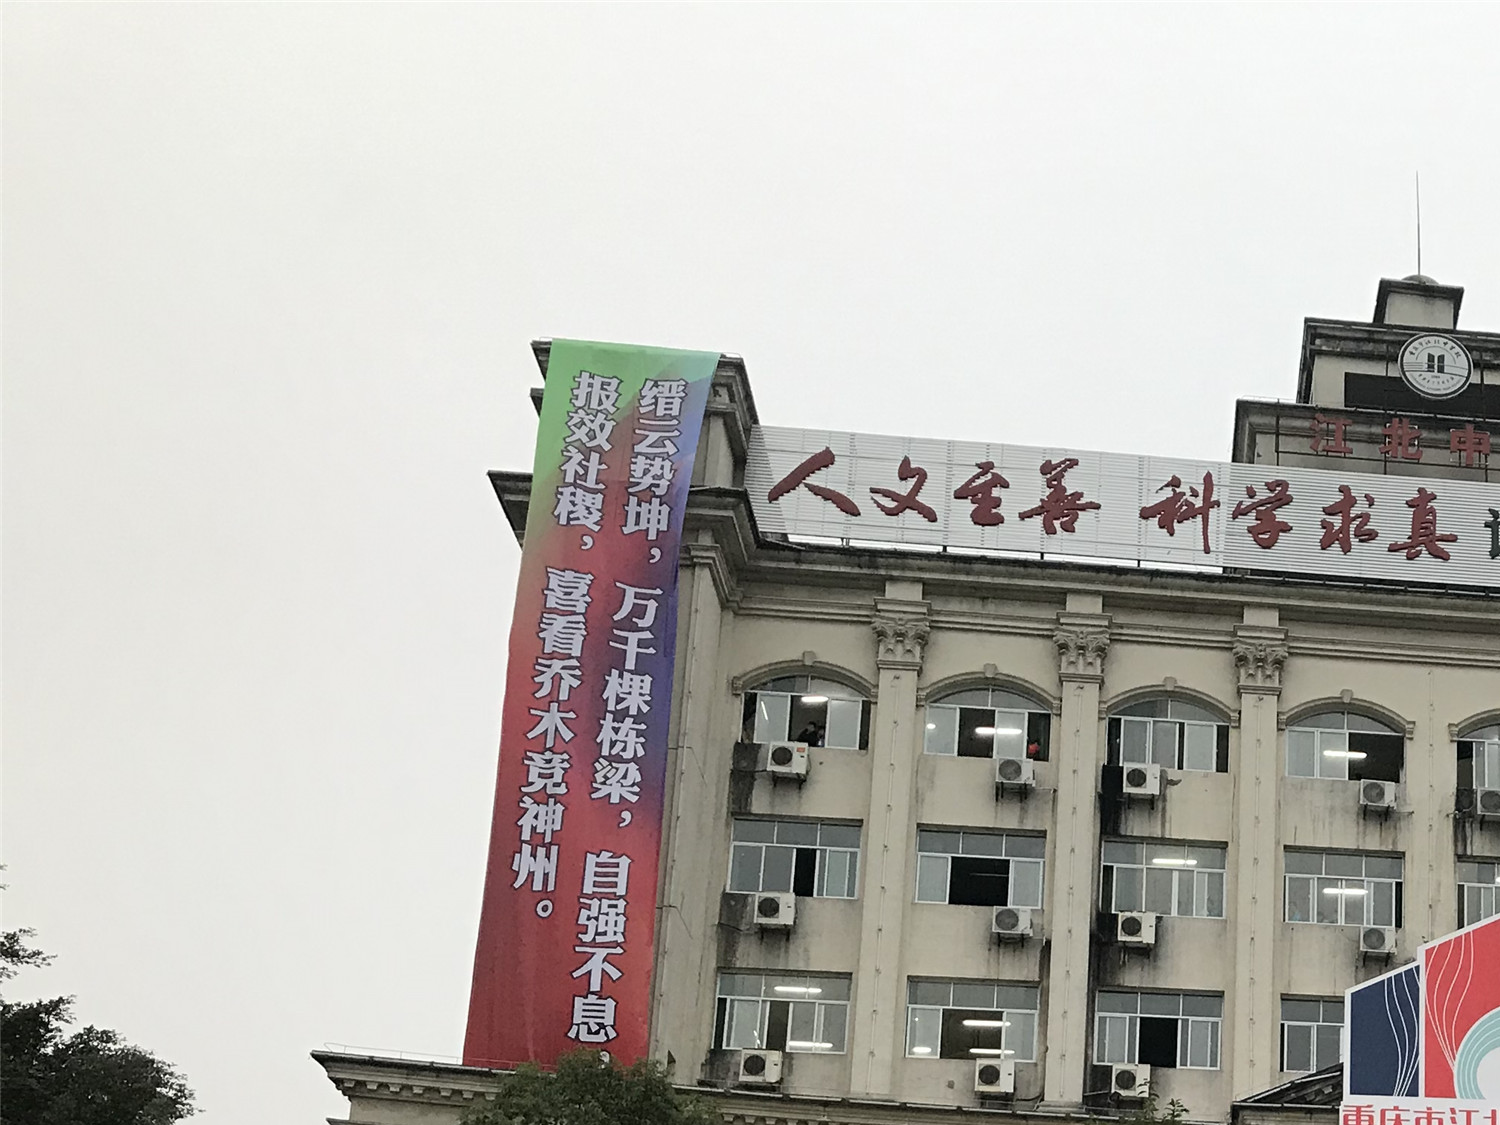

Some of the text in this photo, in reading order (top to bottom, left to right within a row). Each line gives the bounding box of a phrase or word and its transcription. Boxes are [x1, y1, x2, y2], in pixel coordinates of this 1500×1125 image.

[767, 445, 1102, 537] 人文至善
[1139, 470, 1459, 562] 科学求真
